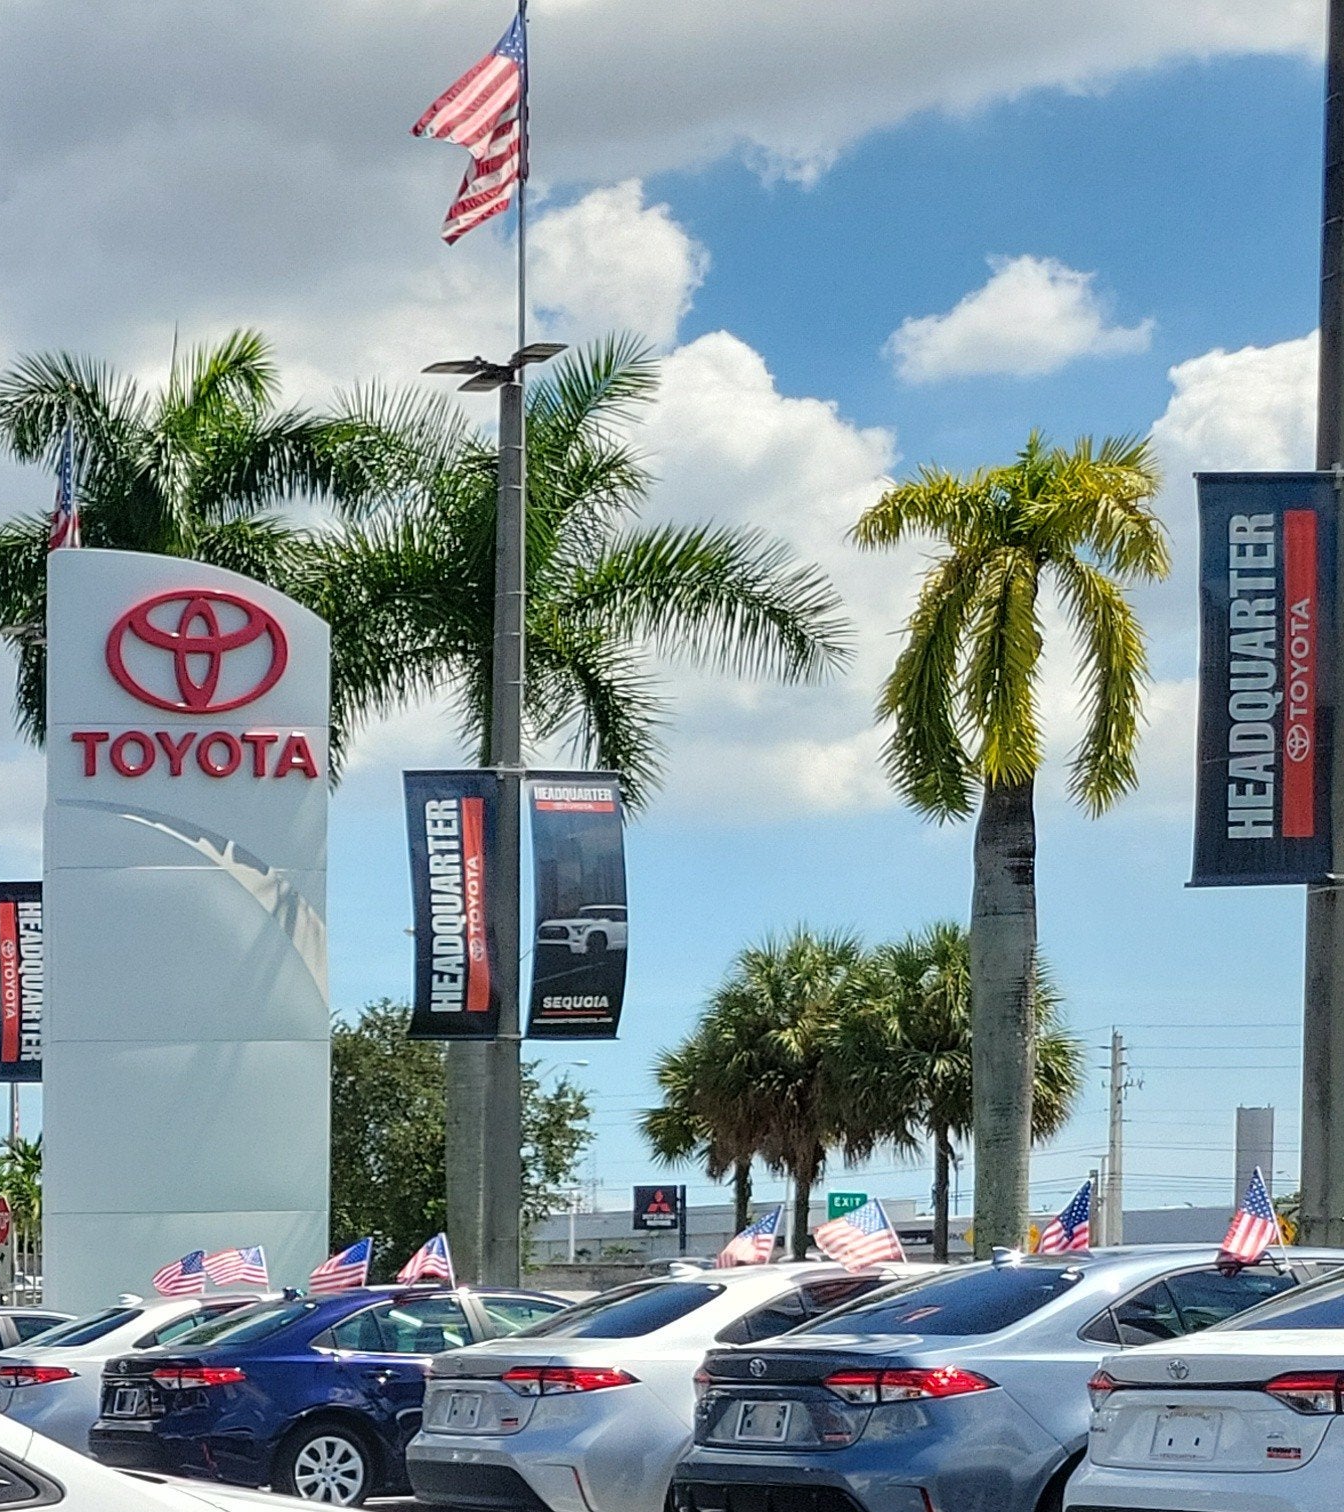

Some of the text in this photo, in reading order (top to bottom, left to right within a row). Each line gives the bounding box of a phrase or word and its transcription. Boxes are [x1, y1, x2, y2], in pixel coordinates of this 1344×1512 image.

[1228, 513, 1283, 839] HEADQUARTER
[1289, 598, 1311, 720] TOYOTA
[71, 730, 319, 779] TOYOTA
[425, 799, 467, 1013] HEADQUARTER
[466, 855, 482, 935] TOYOTA
[2, 960, 16, 1020] TOYOTA
[17, 902, 43, 1061] HEADQUARTER
[542, 995, 609, 1010] SEQUOIA
[834, 1196, 861, 1207] EXIT
